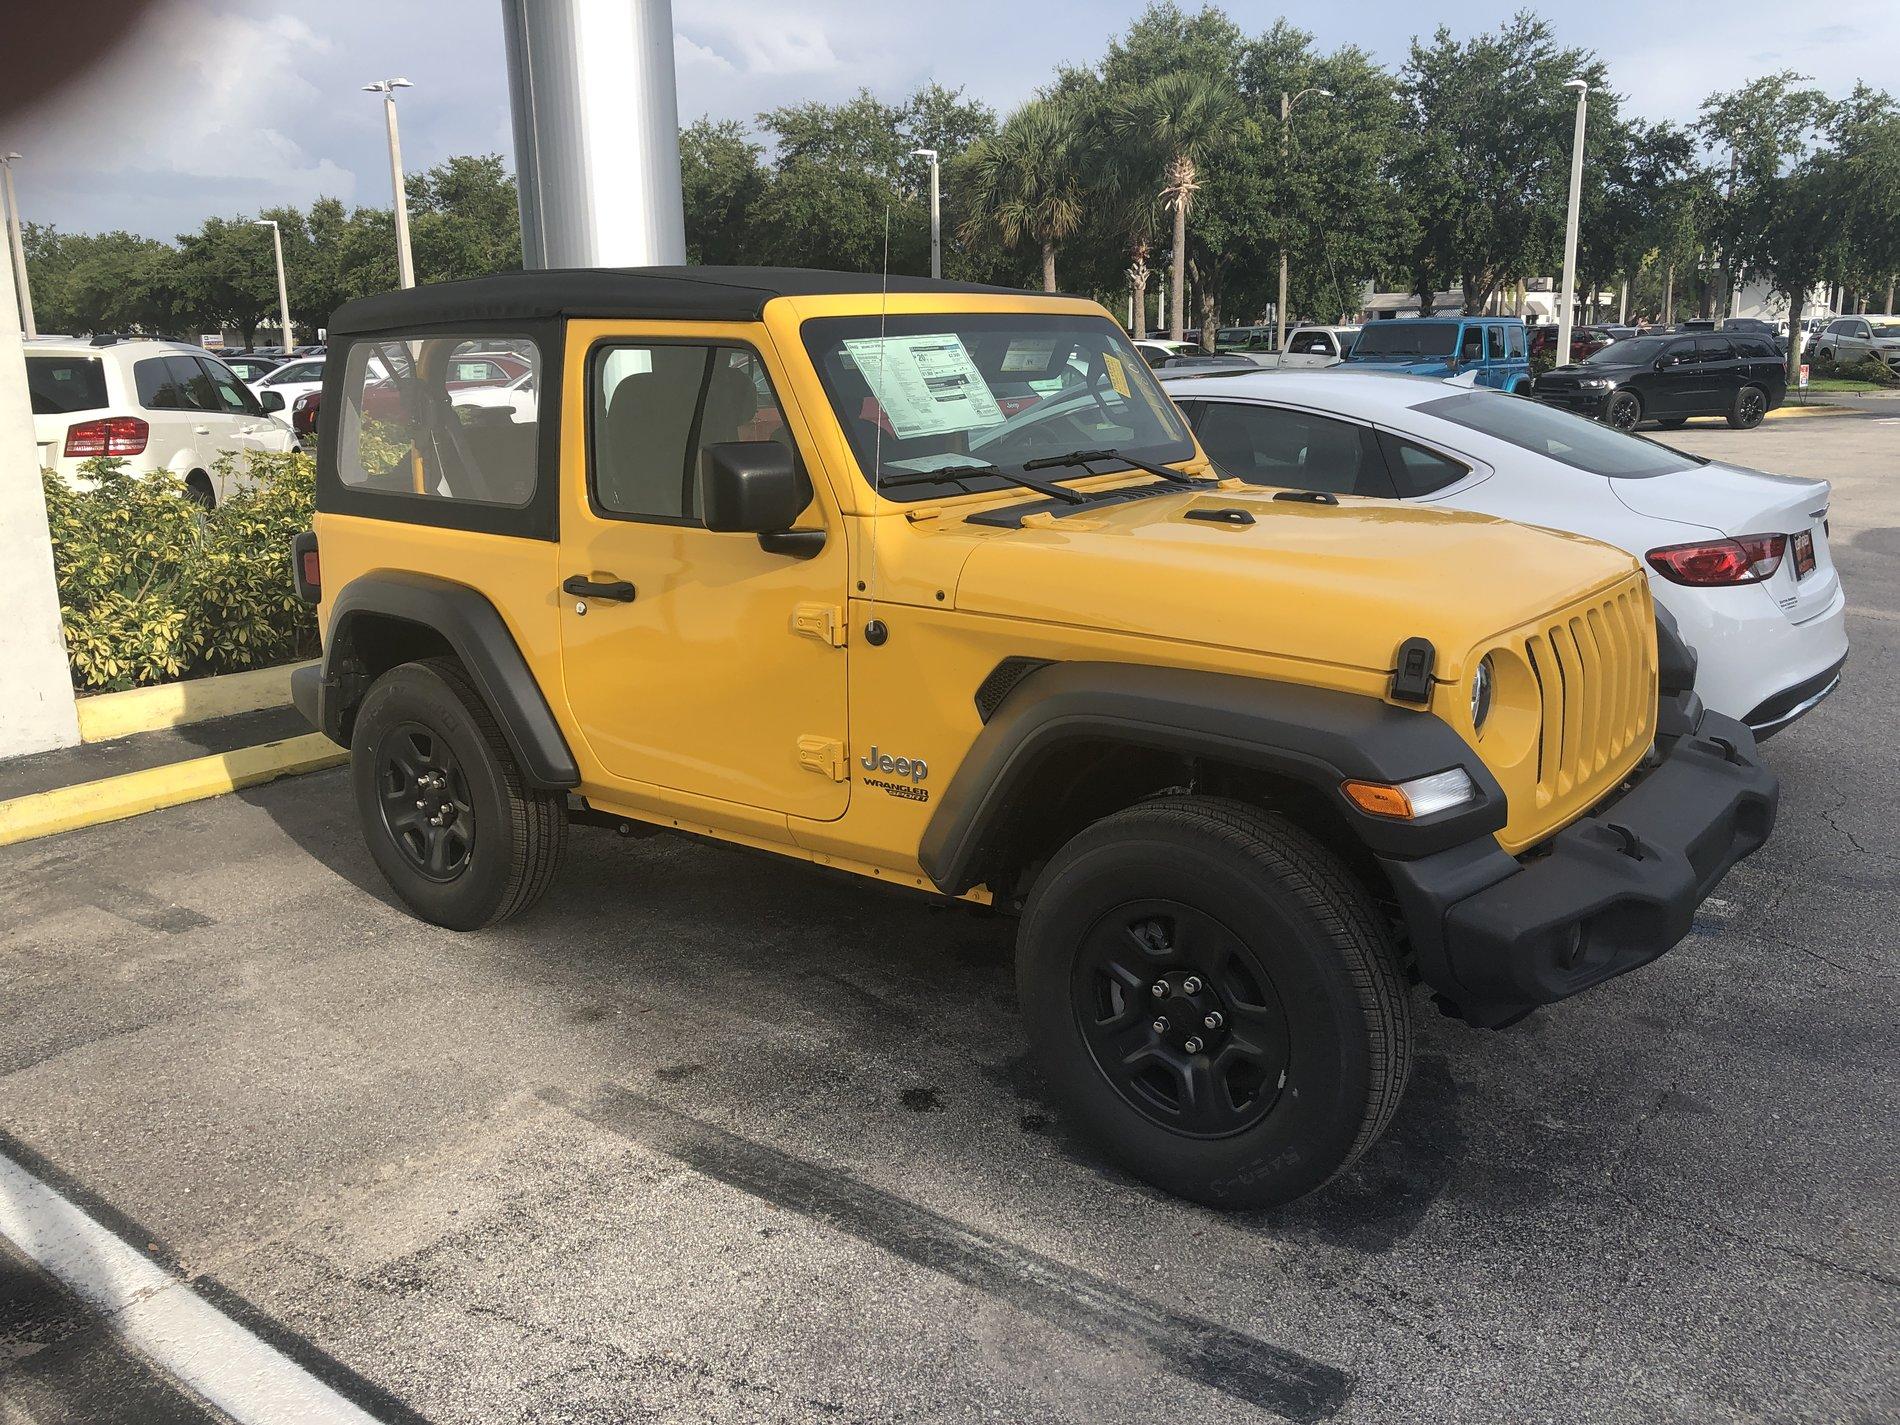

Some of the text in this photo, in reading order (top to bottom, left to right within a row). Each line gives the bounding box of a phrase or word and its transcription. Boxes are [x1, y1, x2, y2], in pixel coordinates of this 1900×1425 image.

[861, 745, 928, 784] Jeep
[863, 777, 929, 797] WRANGLER
[888, 790, 927, 801] SPORT
